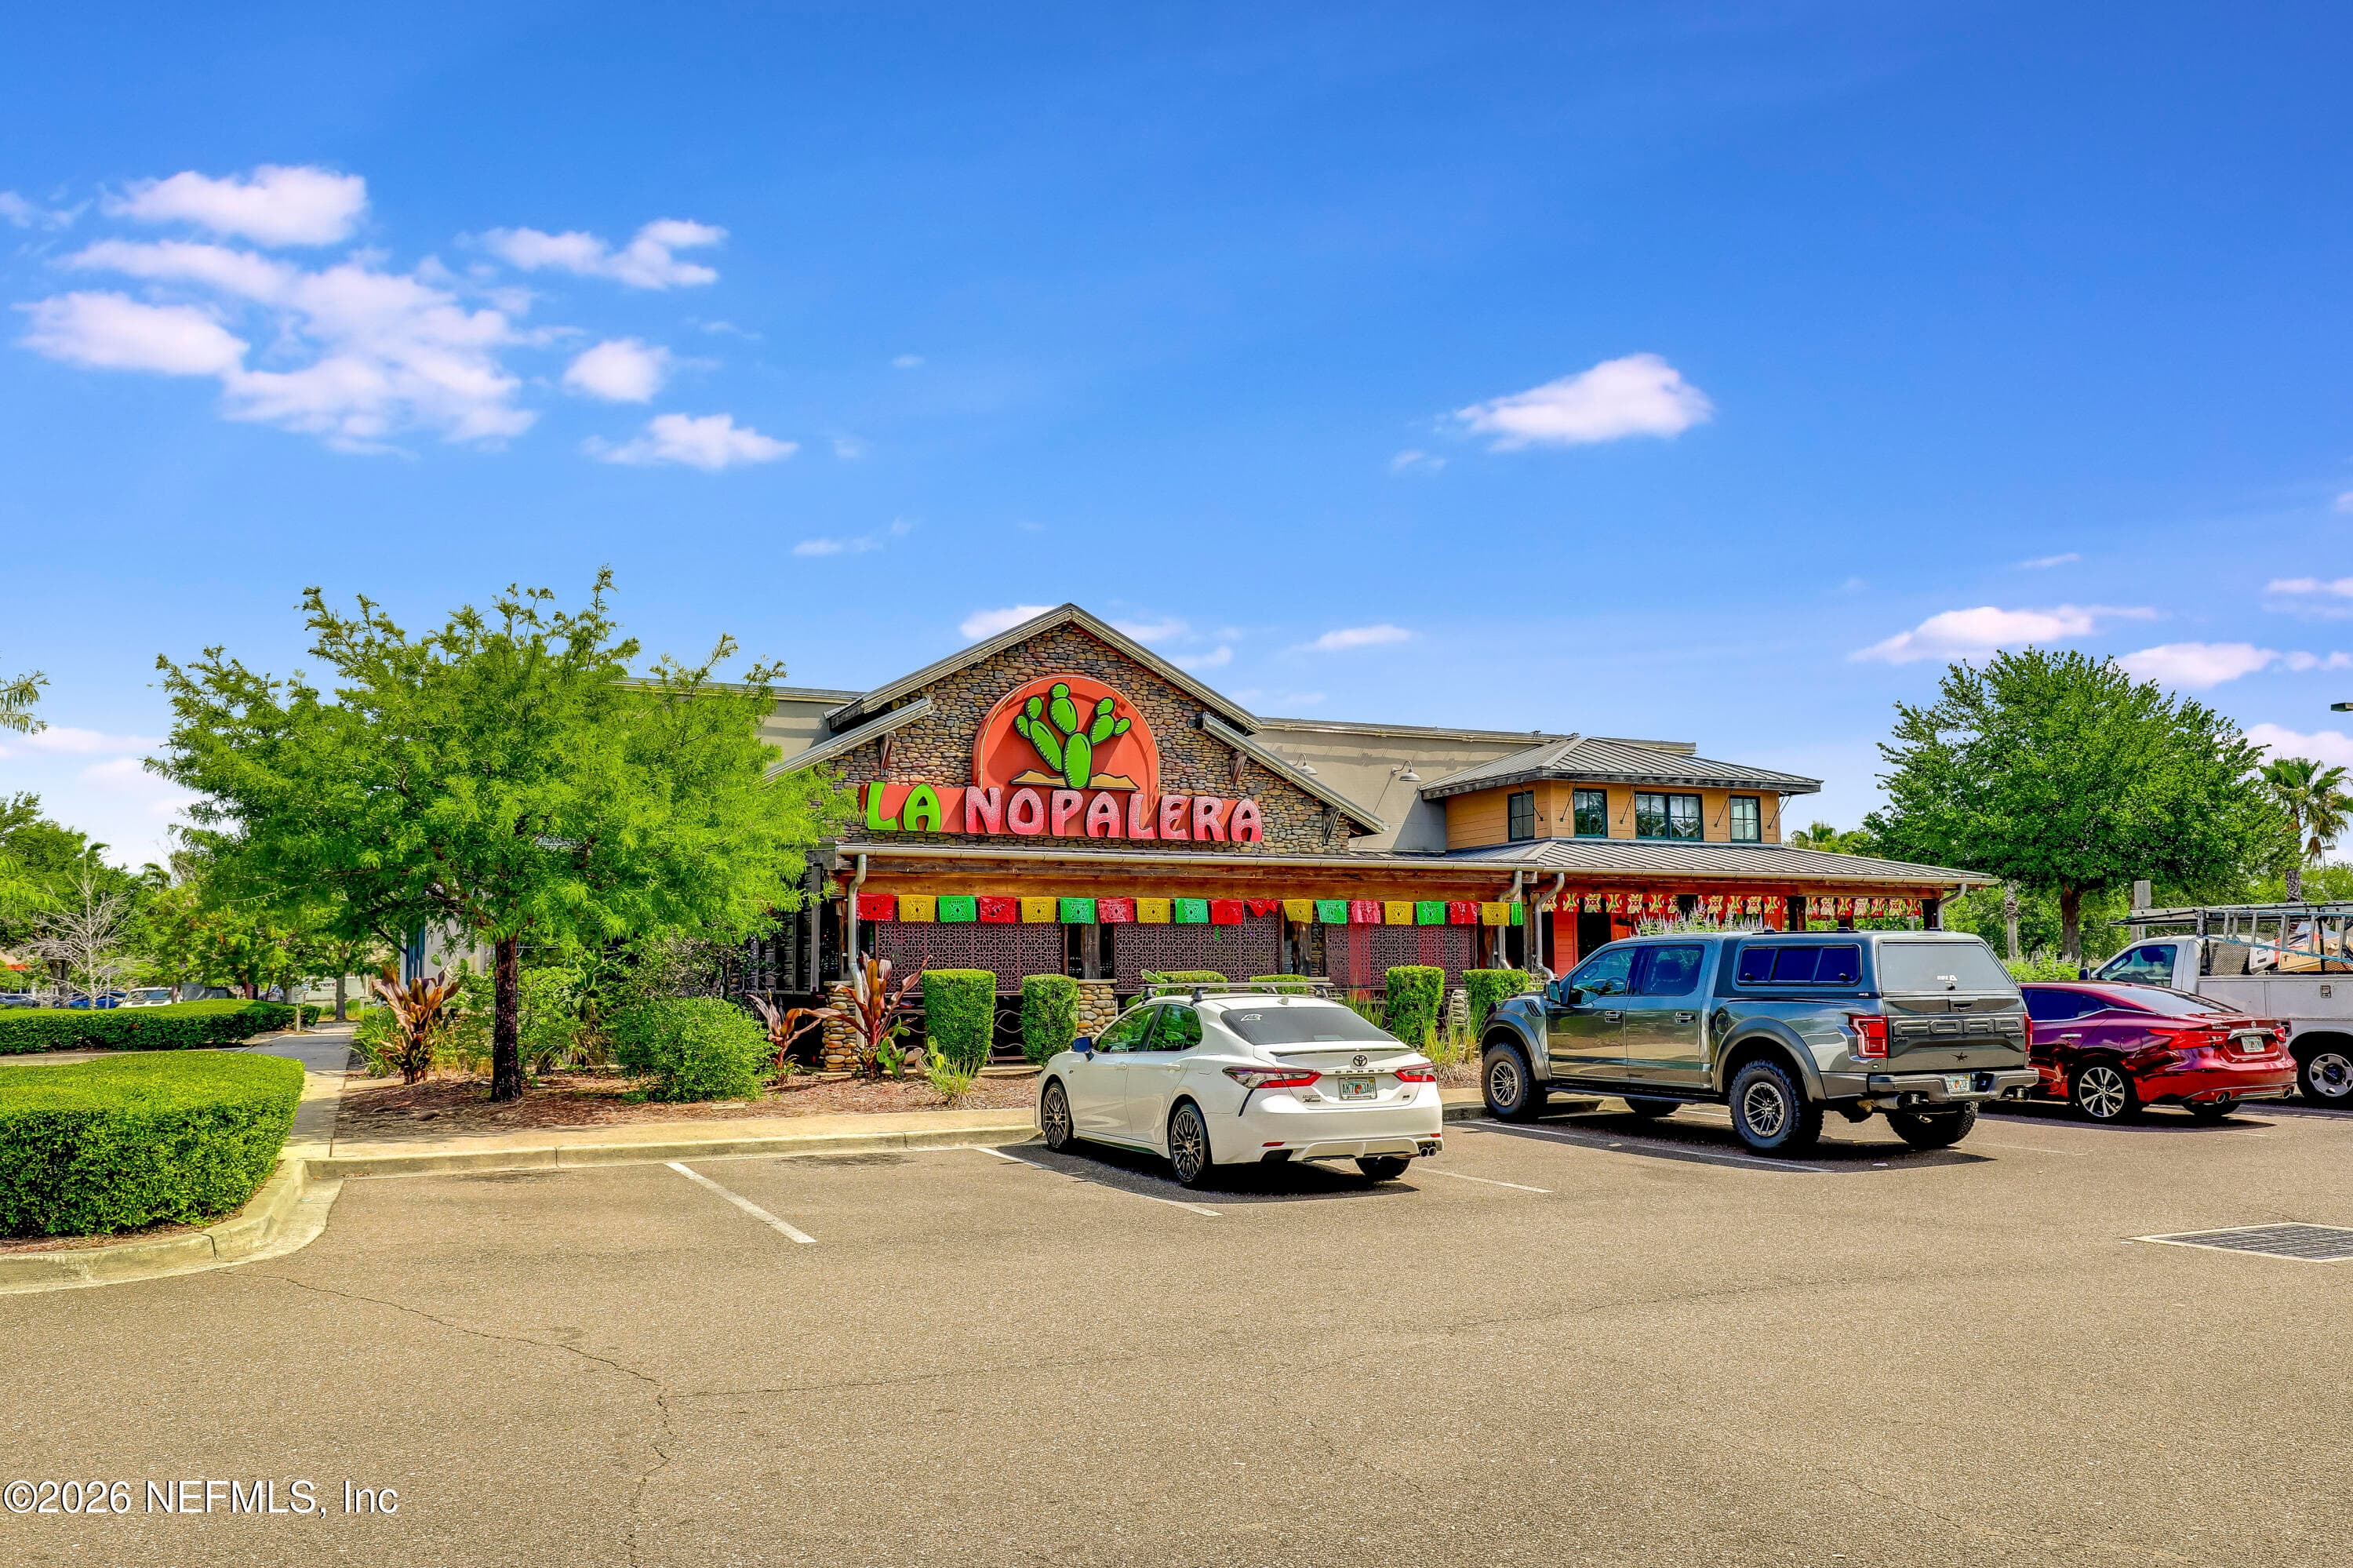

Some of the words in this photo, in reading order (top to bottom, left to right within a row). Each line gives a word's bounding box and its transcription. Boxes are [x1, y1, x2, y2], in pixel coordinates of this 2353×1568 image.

[867, 781, 942, 832] LA
[966, 787, 1263, 842] NOPALERA
[1893, 1017, 2024, 1035] FORD
